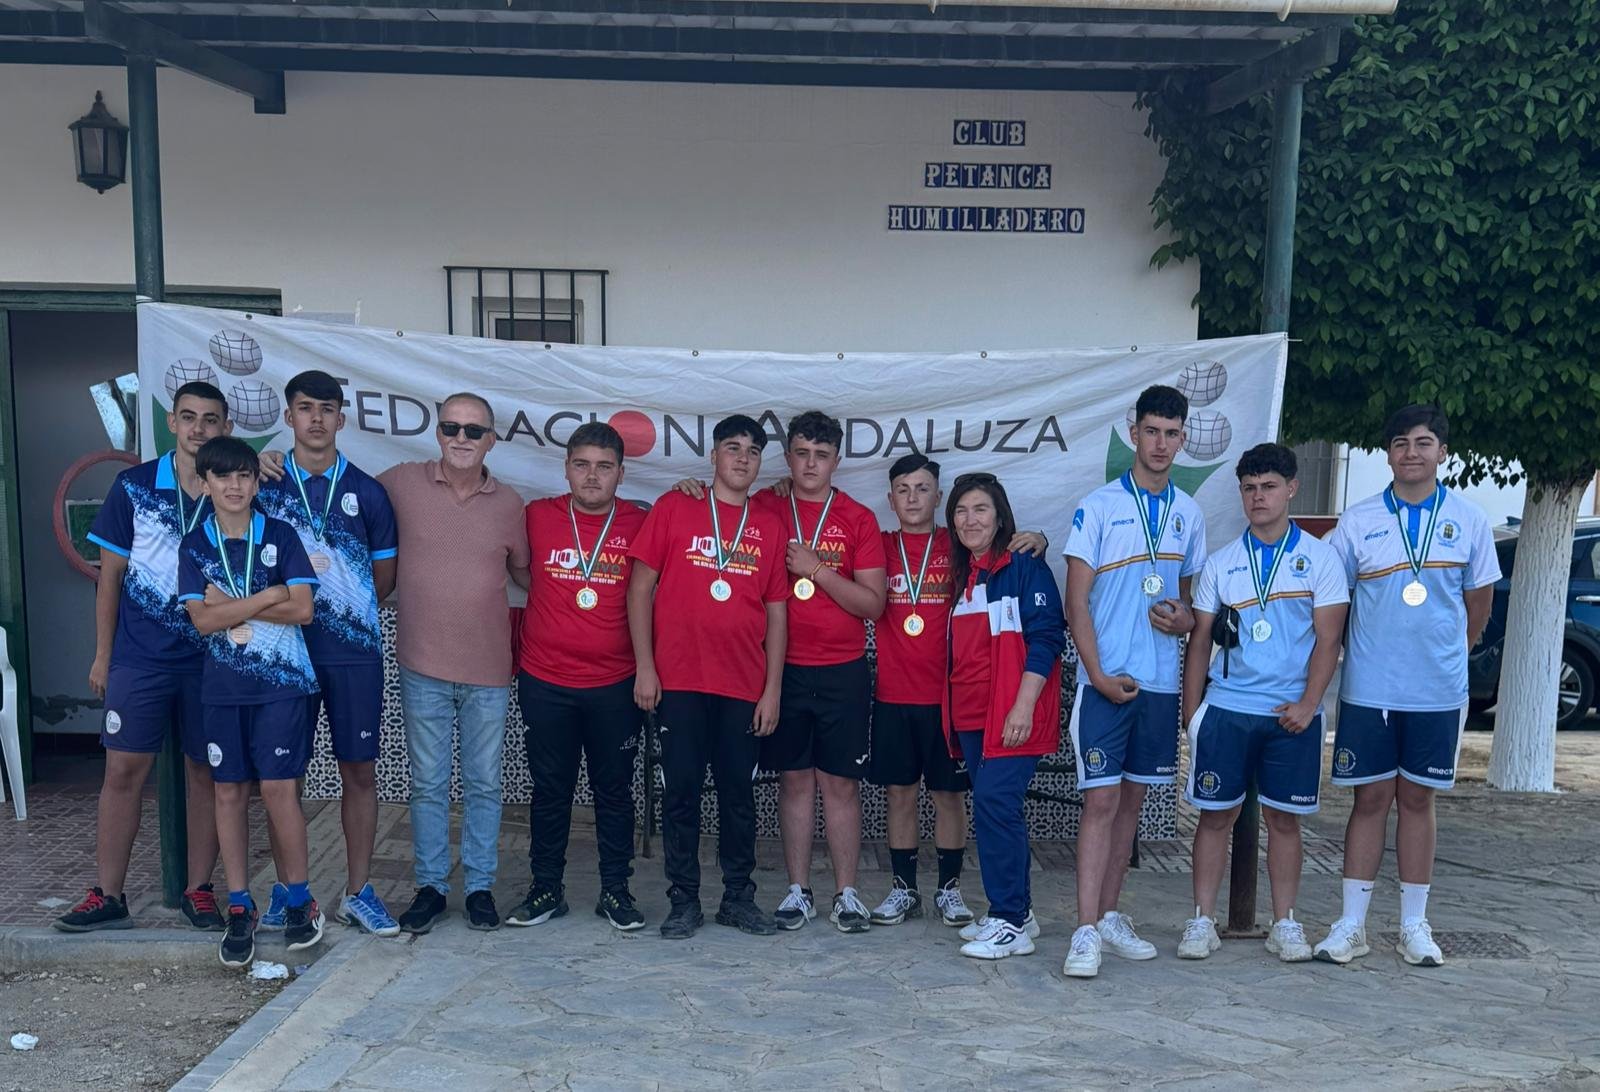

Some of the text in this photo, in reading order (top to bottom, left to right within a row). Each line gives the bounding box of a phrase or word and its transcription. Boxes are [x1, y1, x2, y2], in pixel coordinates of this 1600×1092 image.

[955, 121, 1024, 145] CLUB
[926, 163, 1050, 188] PETANCA
[889, 206, 1084, 231] HUMILLADERO
[333, 377, 1068, 459] EDACON ADALUZA
